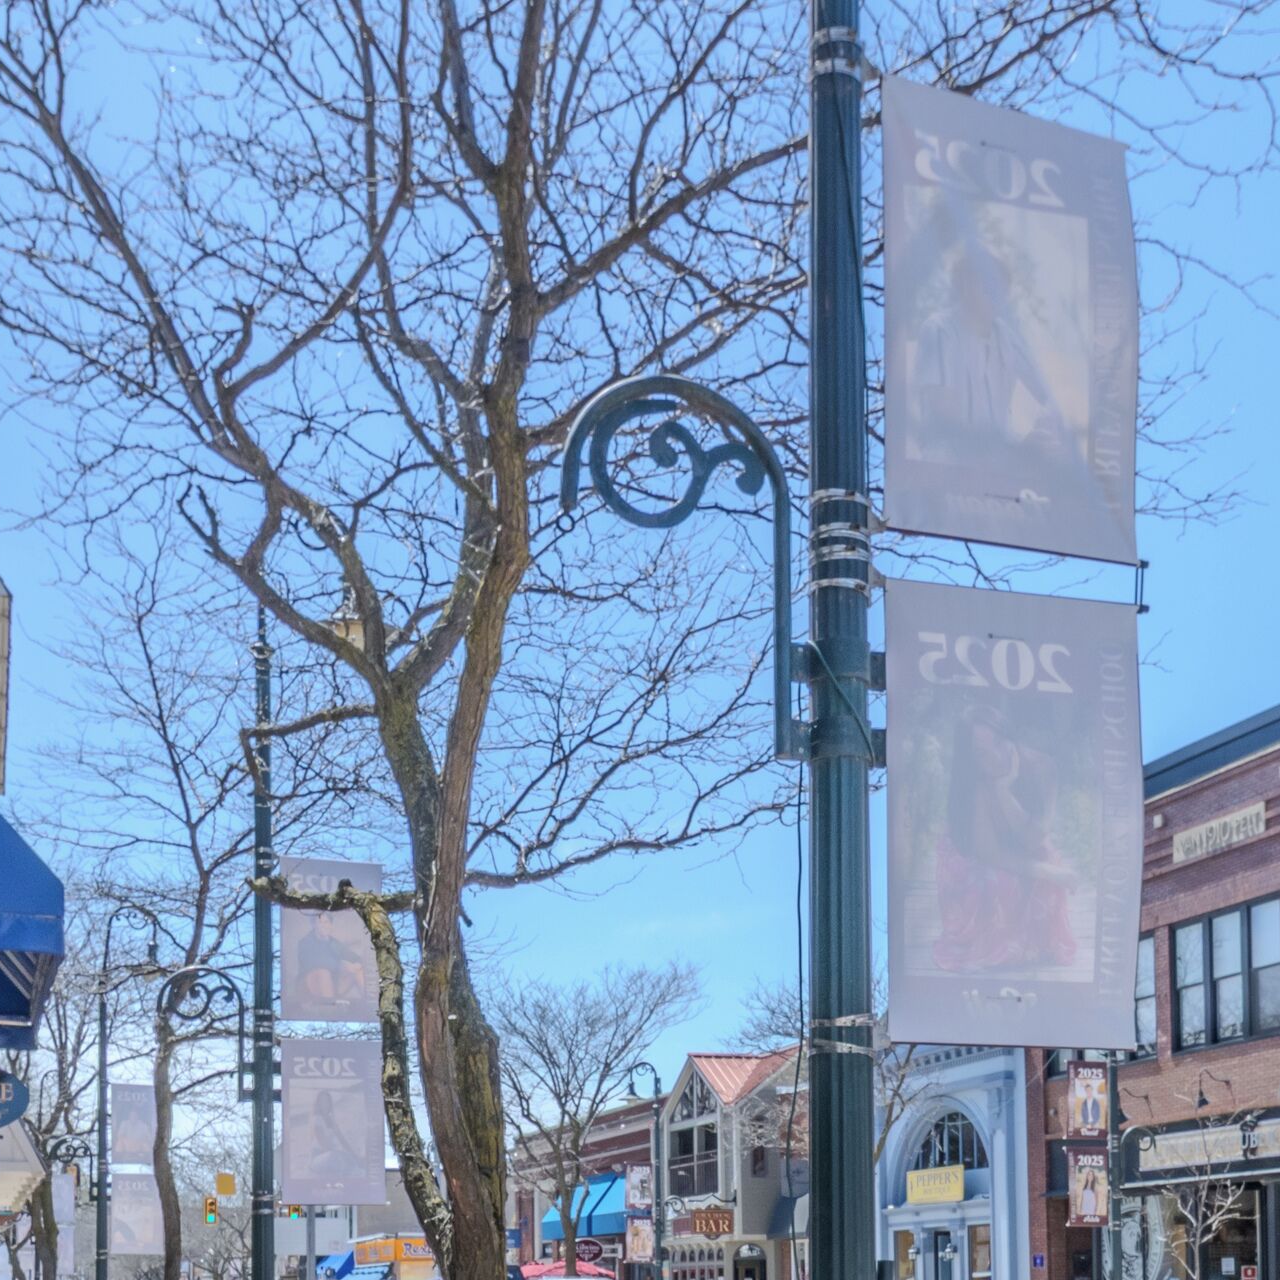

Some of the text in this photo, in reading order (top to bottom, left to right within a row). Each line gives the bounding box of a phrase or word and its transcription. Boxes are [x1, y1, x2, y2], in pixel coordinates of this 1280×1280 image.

[1077, 1068, 1104, 1079] 2025
[1077, 1155, 1104, 1166] 2025
[695, 1219, 730, 1233] BAR
